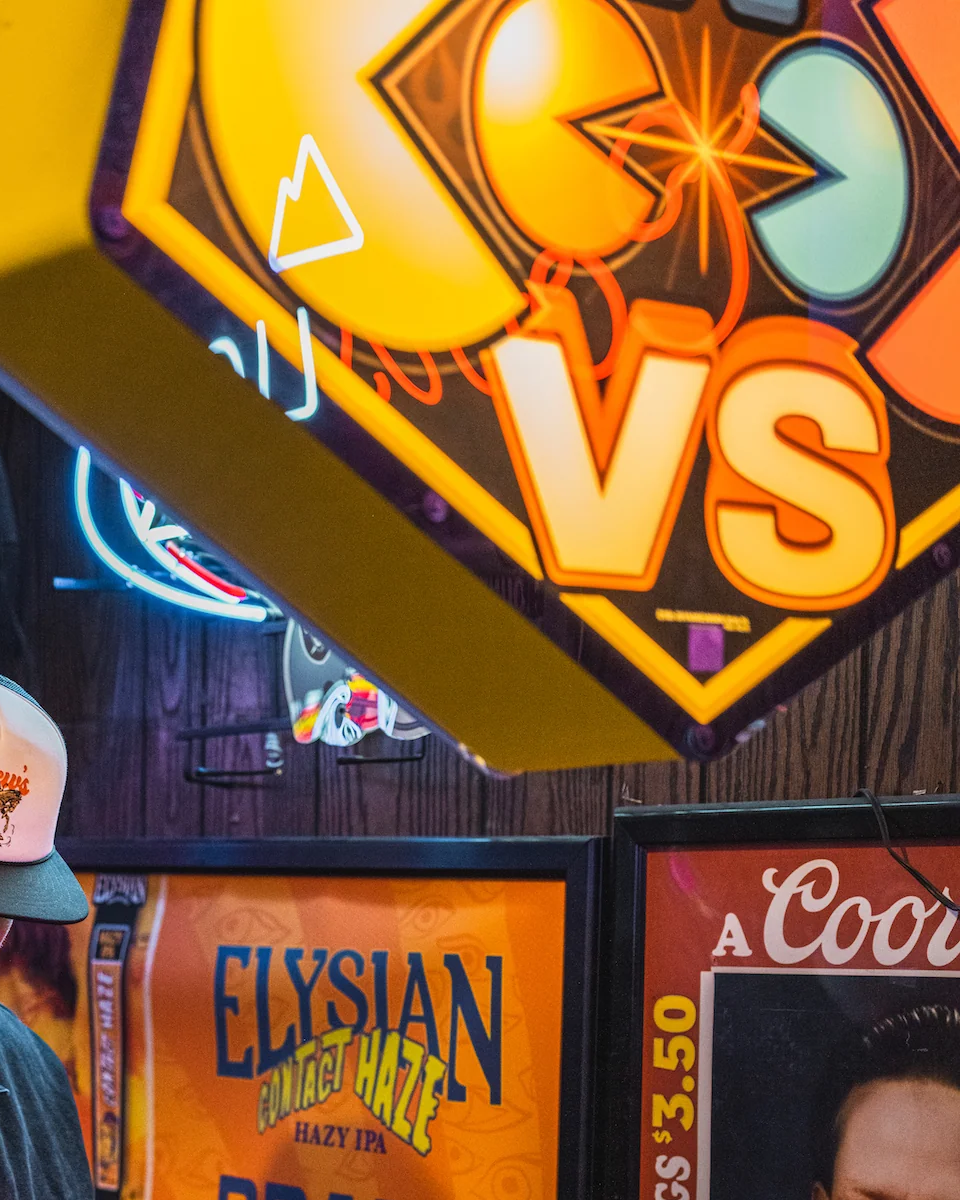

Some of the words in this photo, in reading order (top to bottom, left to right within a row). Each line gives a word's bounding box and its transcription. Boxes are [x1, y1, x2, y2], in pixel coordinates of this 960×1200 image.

[485, 318, 893, 607] VS
[711, 911, 753, 957] A
[214, 945, 503, 1106] ELYSIAN
[257, 1027, 353, 1135] CONTACT
[354, 1027, 448, 1158] HAZE
[652, 994, 697, 1145] $3.50
[295, 1121, 350, 1149] HAZY
[355, 1127, 387, 1154] IPA
